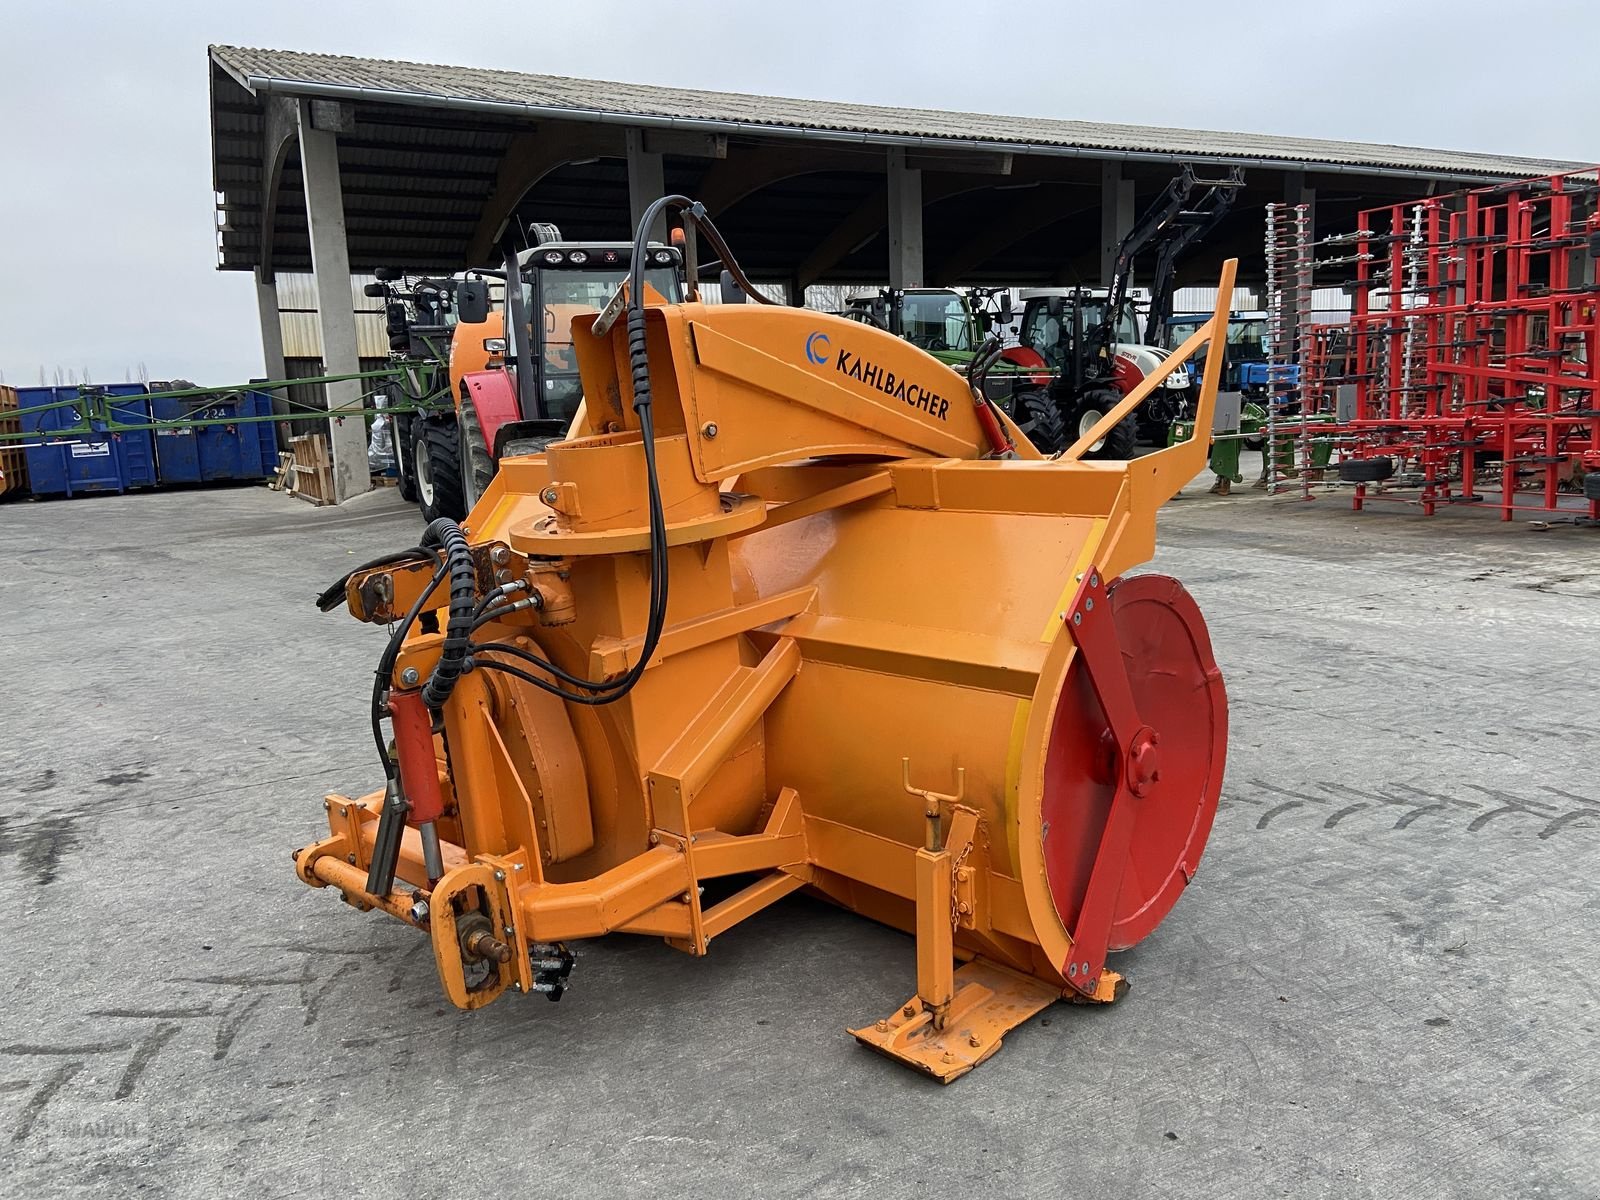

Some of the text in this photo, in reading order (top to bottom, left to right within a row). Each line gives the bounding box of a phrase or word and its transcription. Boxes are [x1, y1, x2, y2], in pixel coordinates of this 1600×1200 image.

[1121, 351, 1137, 361] STEYR
[836, 349, 949, 421] KAHLBACHER
[203, 408, 226, 419] 224
